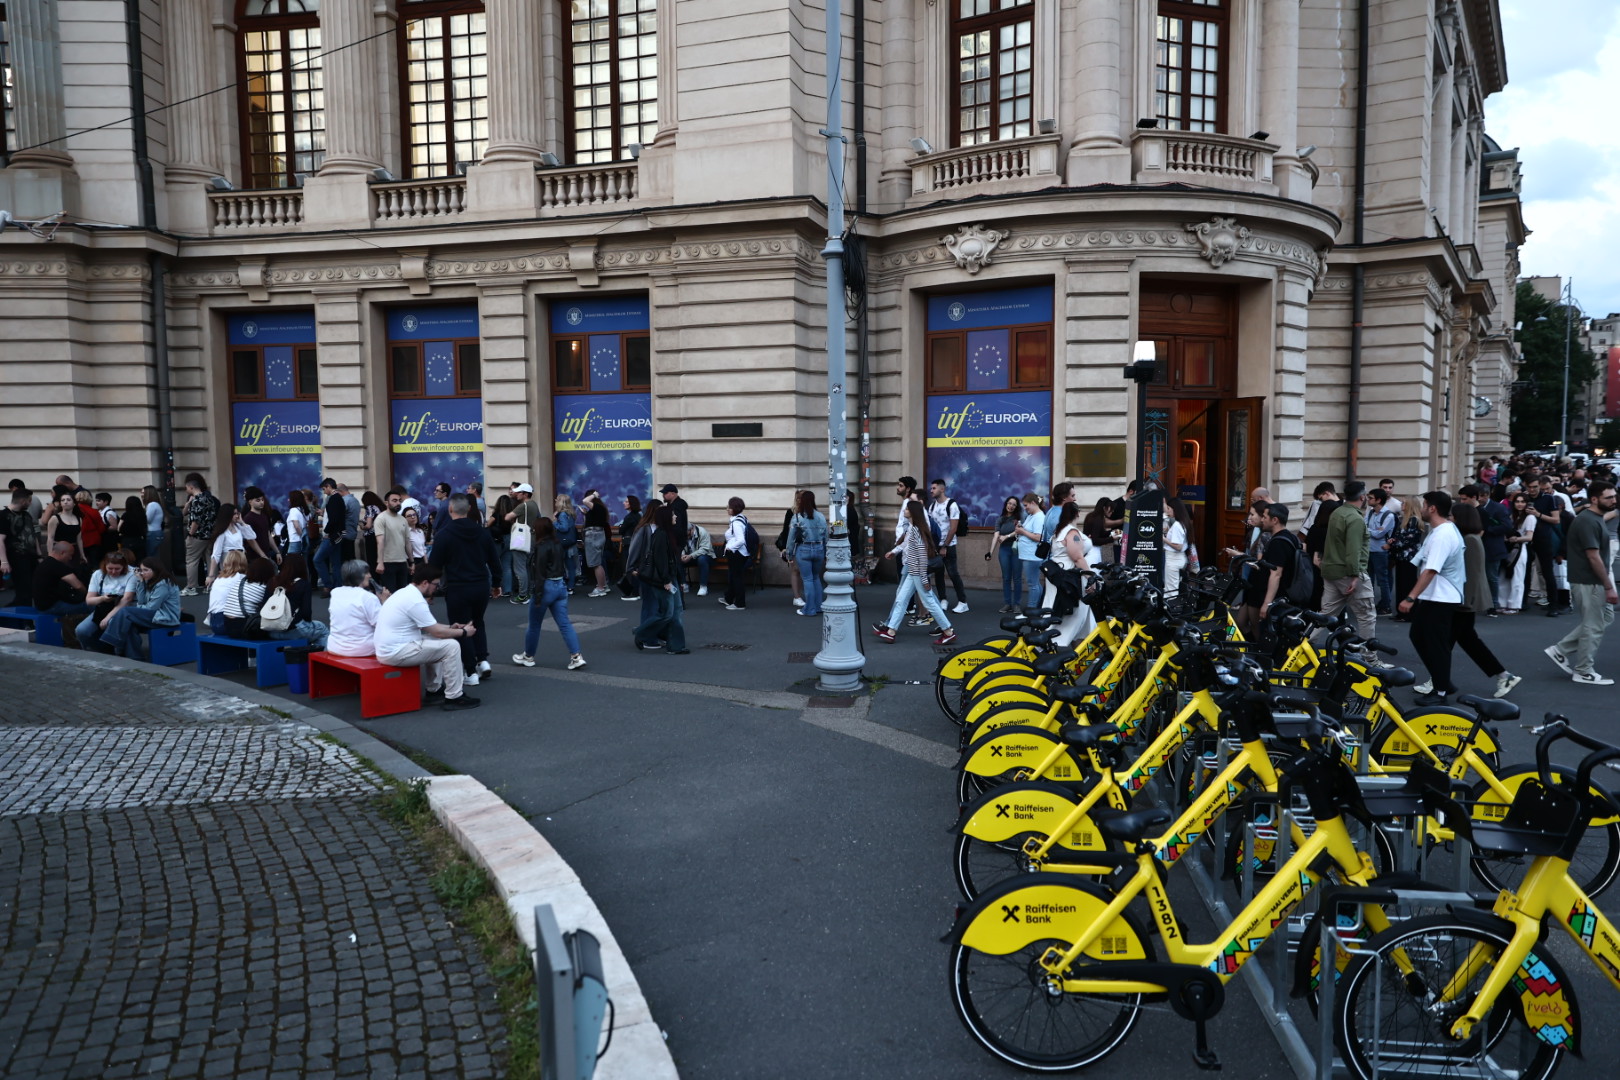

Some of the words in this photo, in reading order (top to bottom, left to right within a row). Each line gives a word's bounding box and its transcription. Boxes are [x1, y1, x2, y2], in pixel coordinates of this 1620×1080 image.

[985, 412, 1038, 424] EUROPA
[574, 441, 641, 450] www.infoeuropa.ro
[951, 438, 1024, 446] www.infoeuropa.ro
[252, 446, 314, 455] www.infoeuropa.ro
[411, 443, 474, 452] www.infoeuropa.ro
[1204, 804, 1213, 814] MAI
[1213, 789, 1227, 804] VERDE
[1013, 804, 1054, 813] Raiffeisen
[1014, 812, 1034, 820] Bank
[1270, 901, 1282, 913] MAI
[1282, 881, 1299, 901] VERDE
[1025, 903, 1077, 914] Raiffeisen
[1151, 885, 1178, 939] 1382
[1025, 915, 1052, 924] Bank
